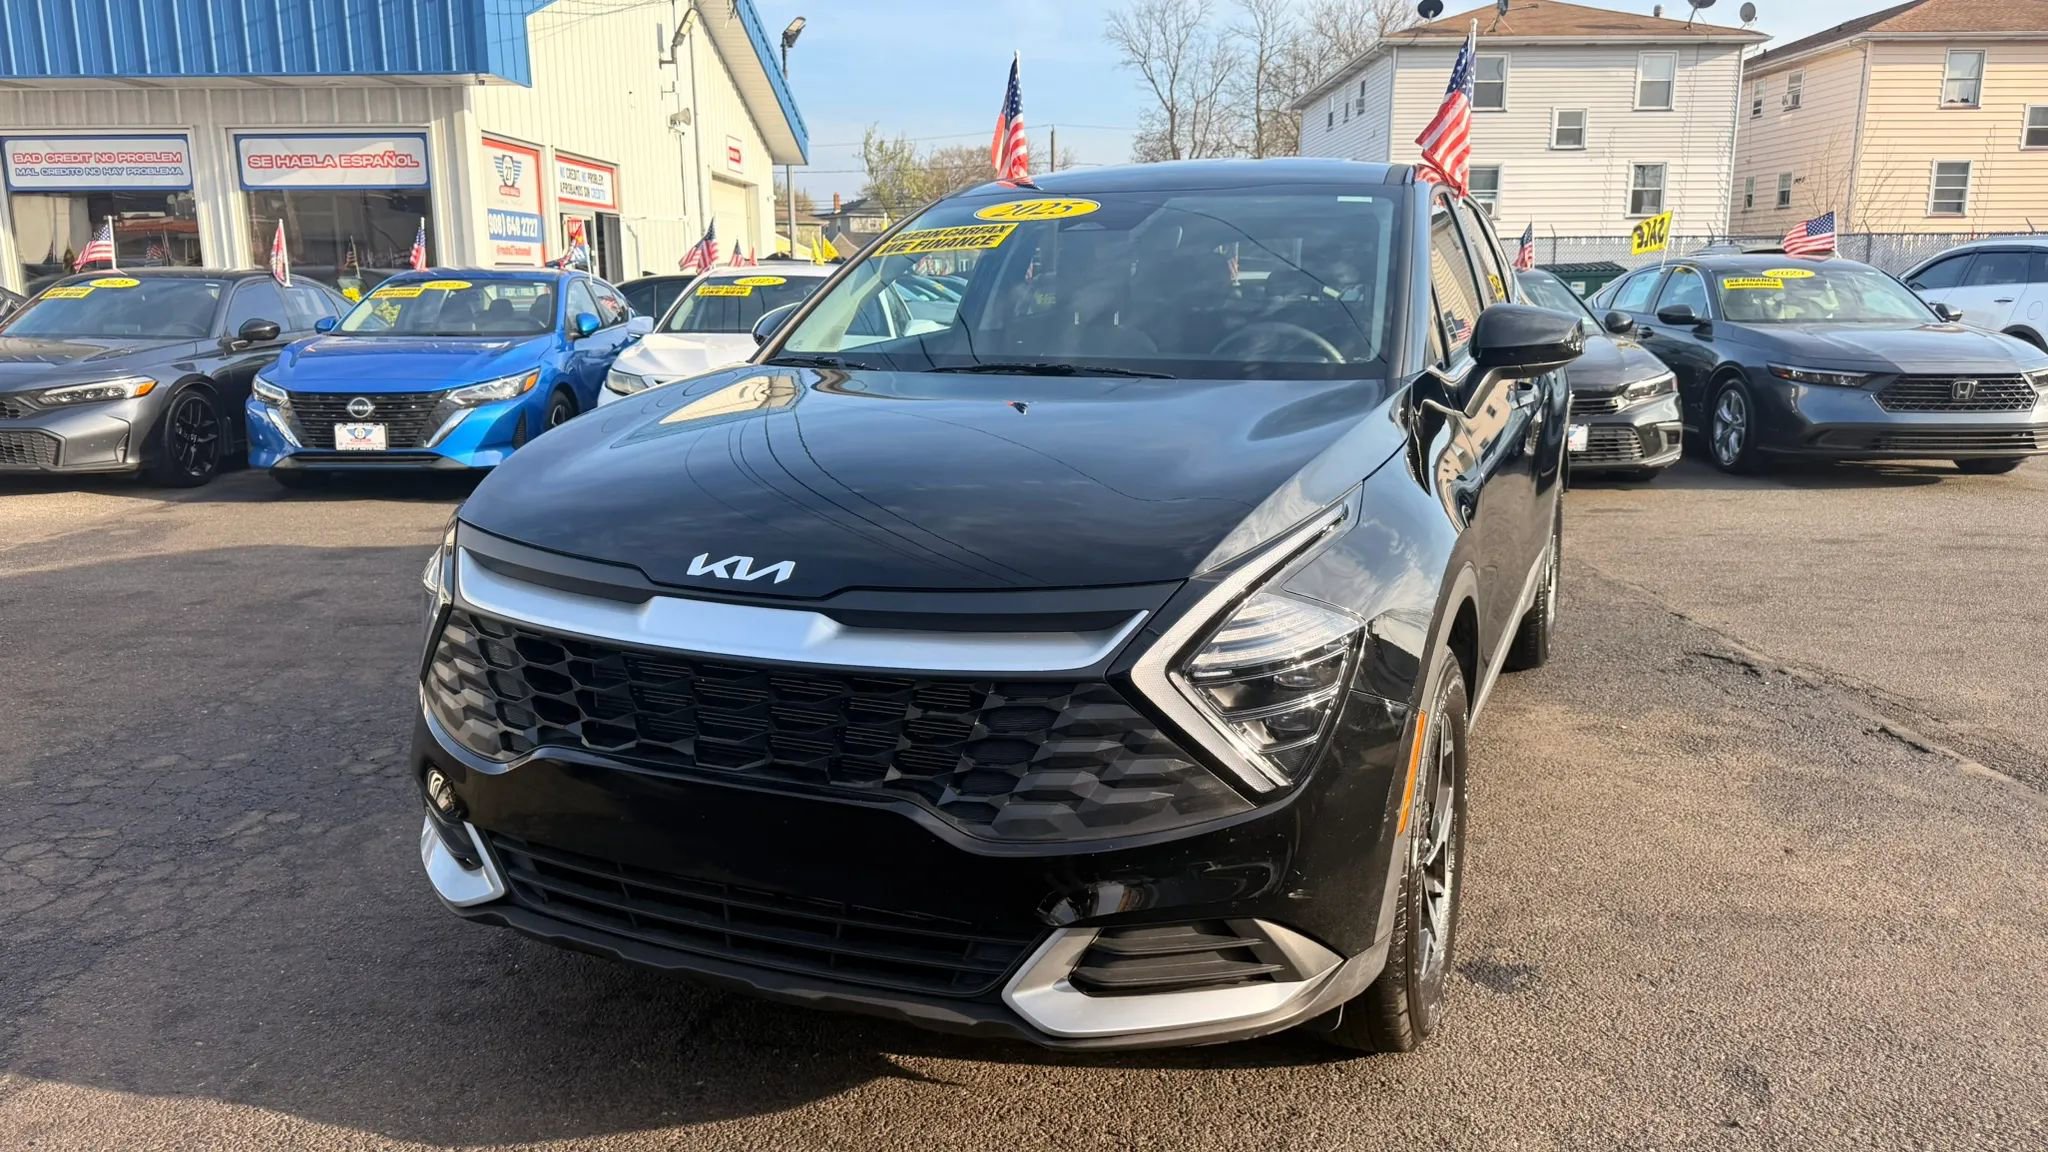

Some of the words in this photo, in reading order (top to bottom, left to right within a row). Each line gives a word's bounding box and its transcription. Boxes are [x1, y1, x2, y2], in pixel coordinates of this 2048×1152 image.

[13, 153, 42, 164] BAD
[45, 153, 92, 164] CREDIT
[95, 153, 114, 163] NO
[117, 152, 182, 163] PROBLEM
[248, 154, 274, 168] SE
[275, 154, 337, 168] HABLA
[339, 151, 419, 168] ESPAÑOL
[15, 168, 39, 177] MAL
[41, 168, 83, 176] CREDITO
[85, 168, 100, 176] NO
[102, 167, 125, 176] HAY
[126, 167, 183, 176] PROBLEMA
[993, 201, 1085, 217] 2025
[521, 217, 538, 237] 2727
[890, 229, 942, 243] CLEAN
[943, 224, 1010, 238] CARFAX
[880, 242, 909, 254] WE
[911, 234, 1000, 250] FINANCE
[687, 553, 795, 584] KIA
